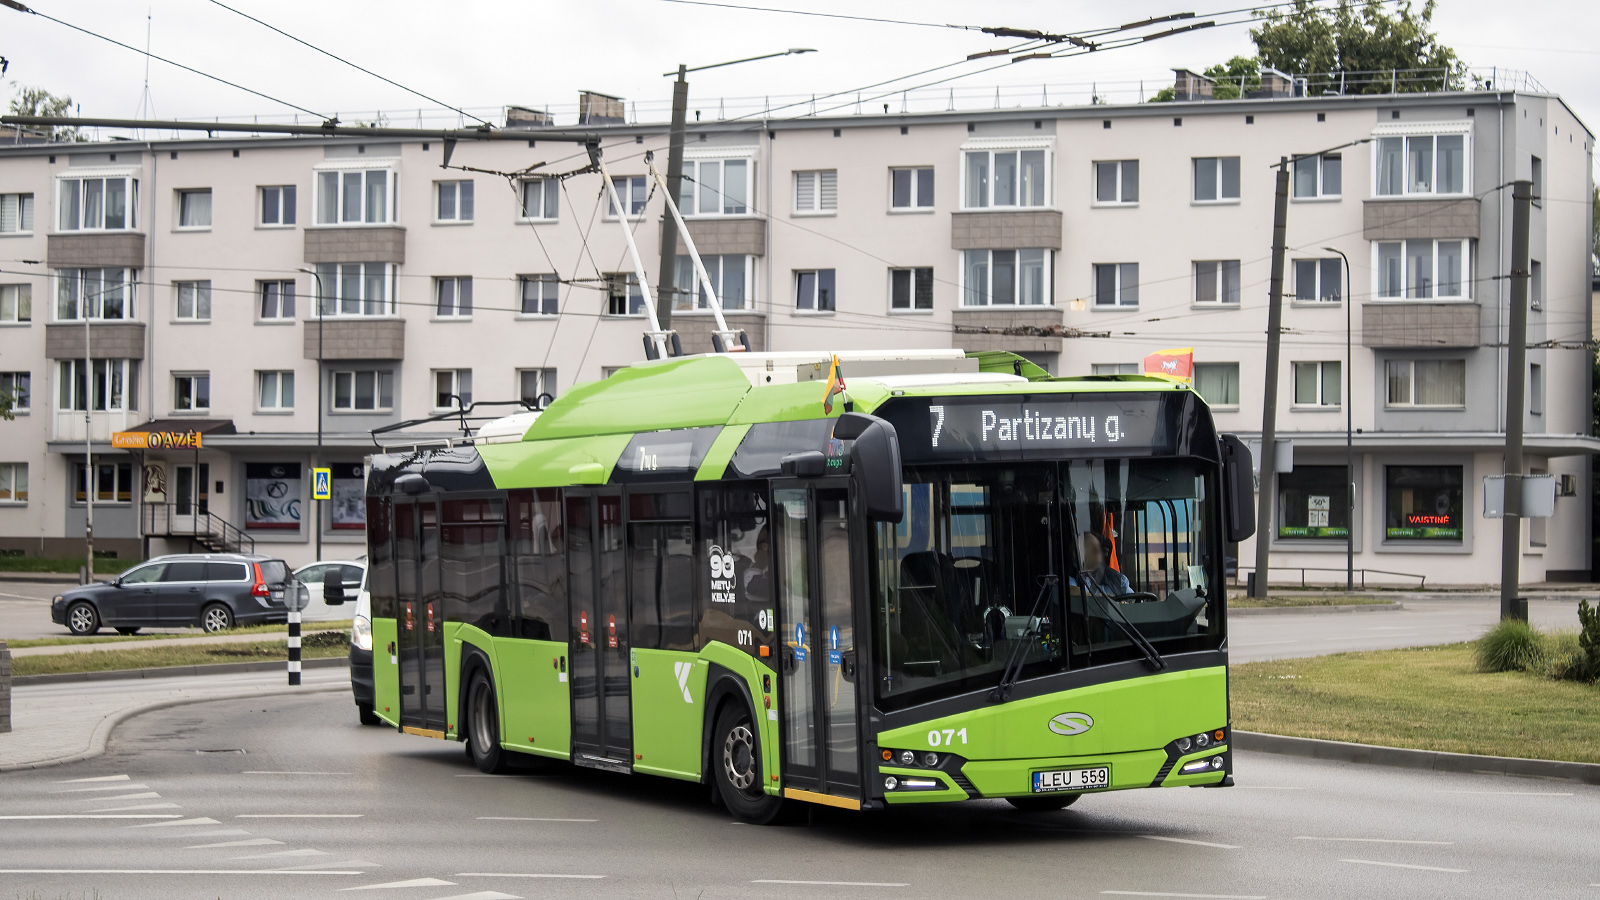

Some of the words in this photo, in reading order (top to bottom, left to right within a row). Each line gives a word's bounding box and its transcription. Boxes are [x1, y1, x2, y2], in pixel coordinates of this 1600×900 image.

[929, 405, 945, 447] 7
[981, 409, 1096, 443] Partizanų
[1105, 415, 1125, 442] g.
[147, 428, 198, 449] OAZĖ
[1408, 514, 1450, 524] VAISTINĖ
[710, 554, 735, 579] 90
[711, 593, 736, 603] KELYJE
[737, 629, 753, 646] 071
[927, 727, 968, 747] 071
[1042, 772, 1072, 787] LEU
[1081, 769, 1106, 784] 559
